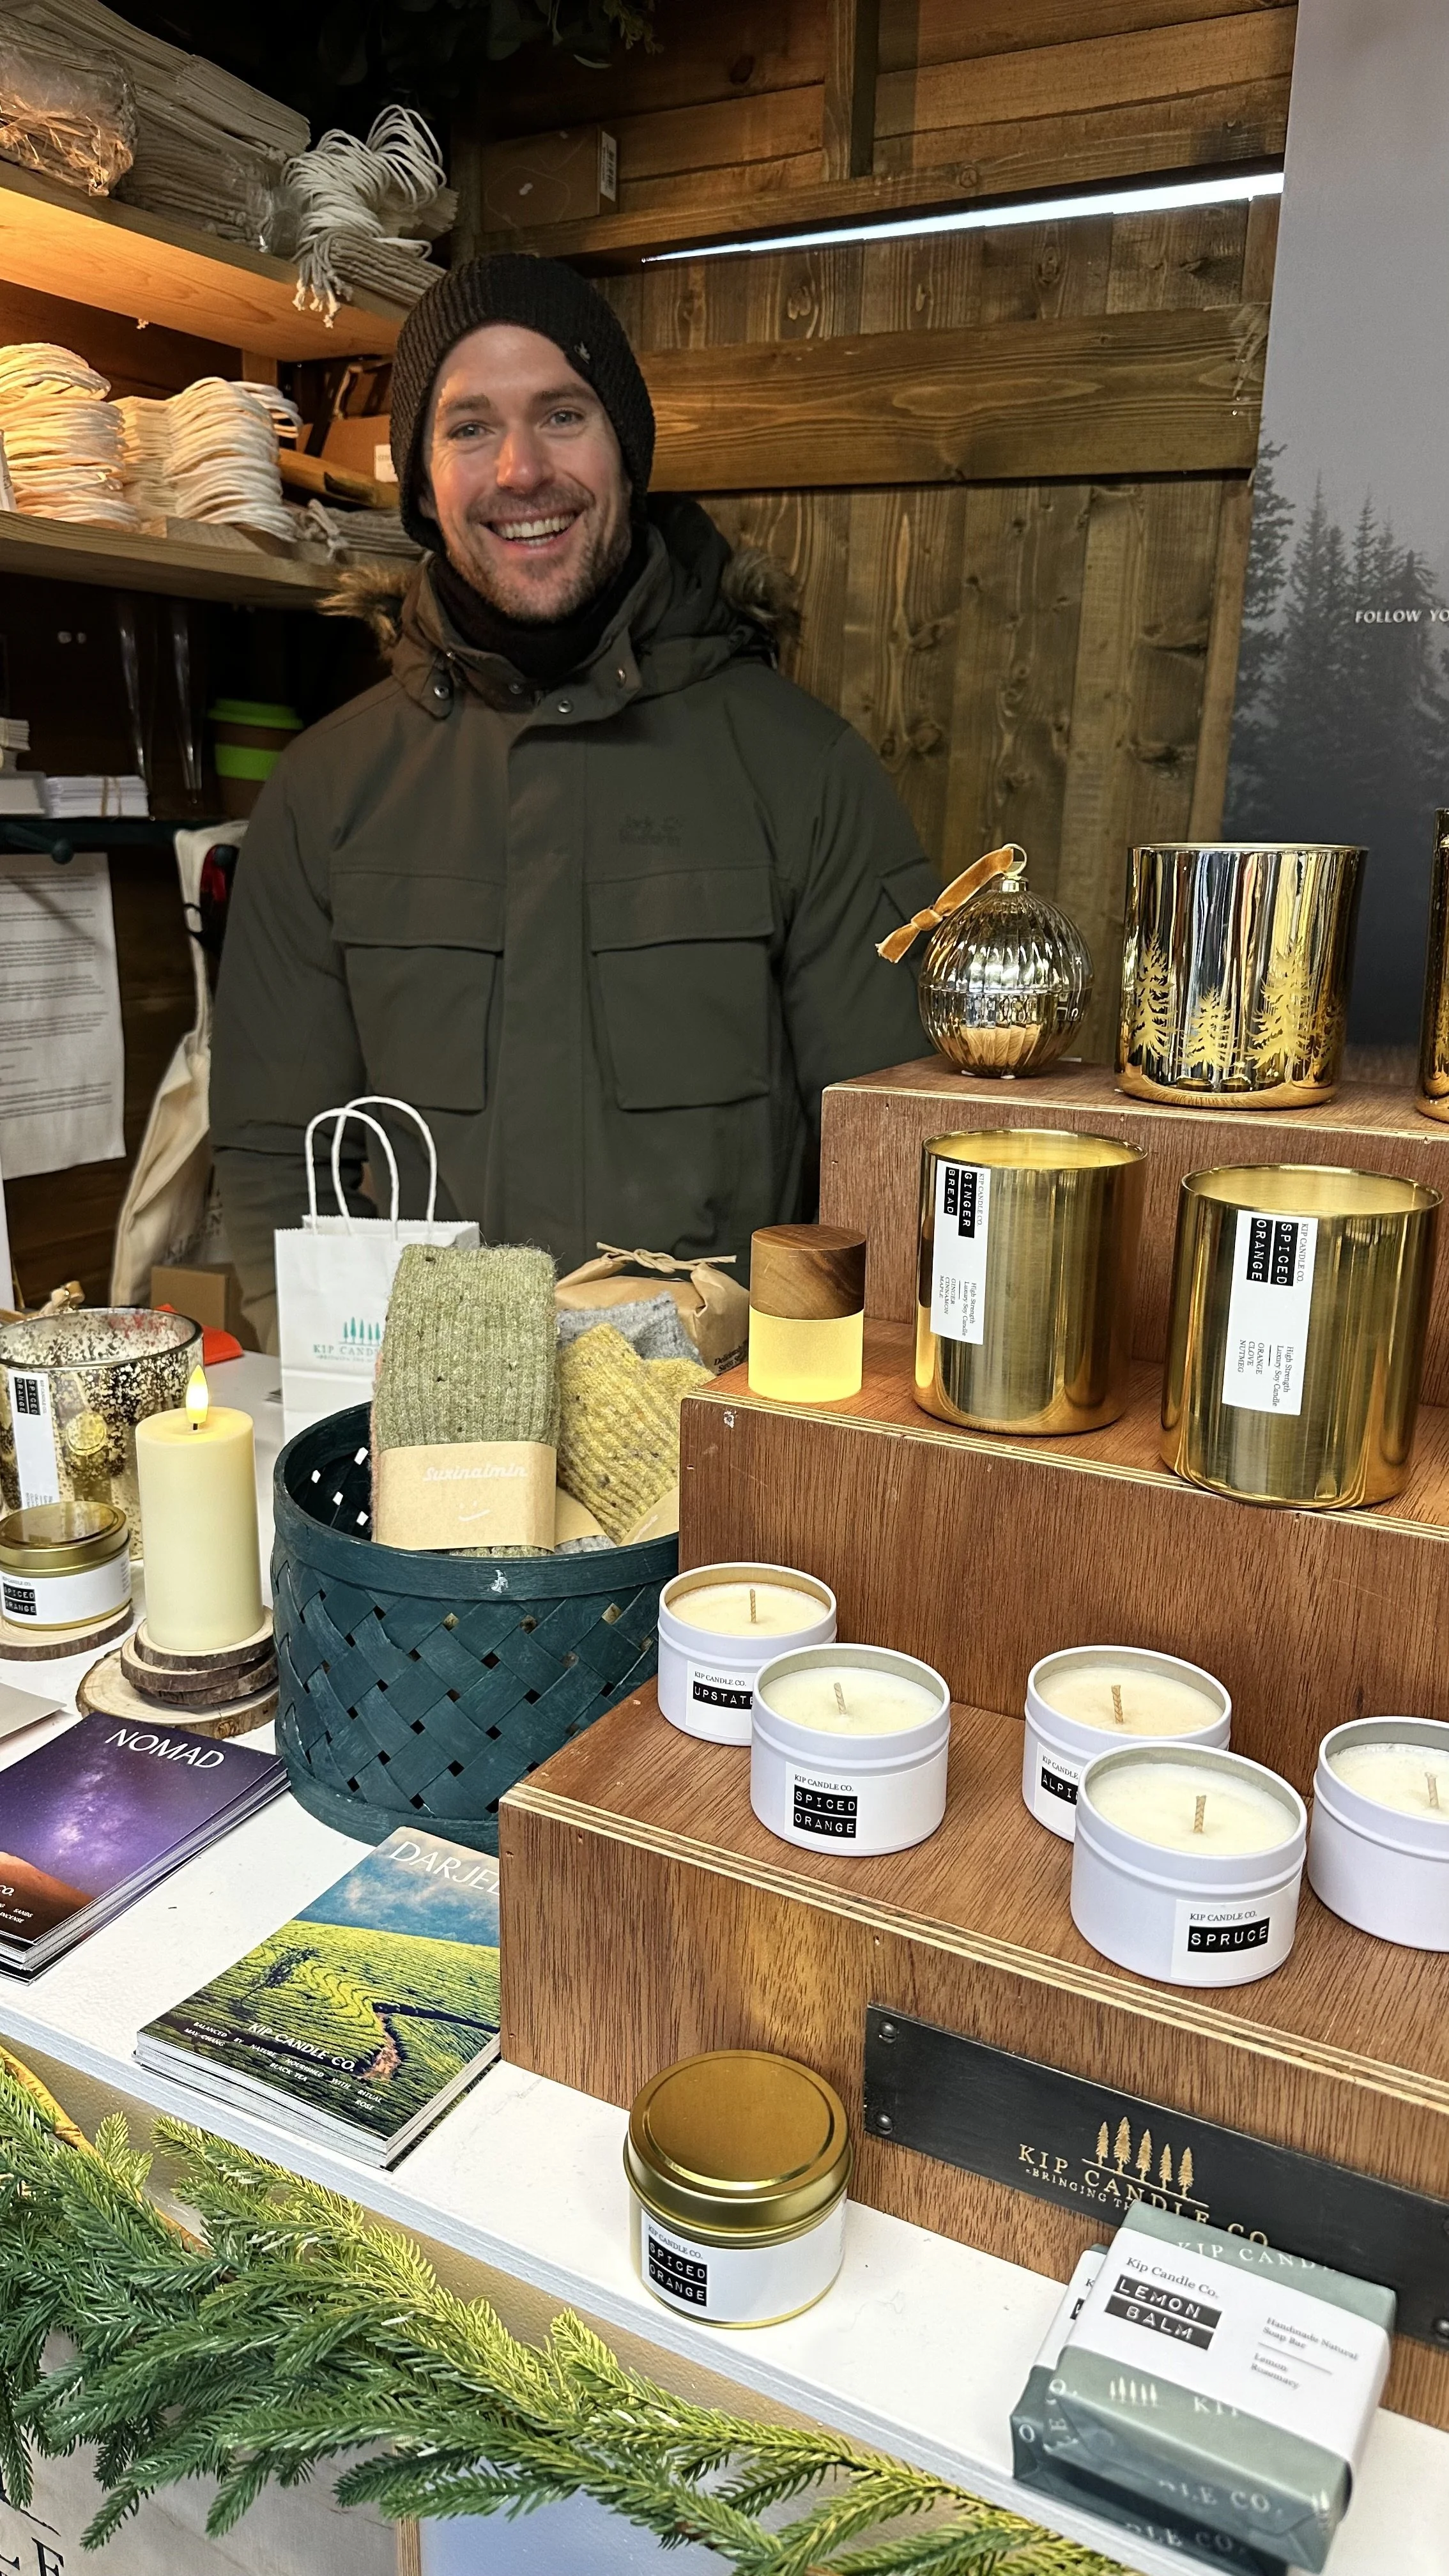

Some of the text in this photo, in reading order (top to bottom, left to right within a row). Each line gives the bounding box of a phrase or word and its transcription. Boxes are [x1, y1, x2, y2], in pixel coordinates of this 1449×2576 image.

[1354, 609, 1422, 624] FOLLOW
[947, 1169, 956, 1213] BREAD
[962, 1172, 972, 1227] GINGER
[1252, 1220, 1267, 1280] ORANGE
[1276, 1223, 1292, 1284] SPICED
[1298, 1238, 1307, 1269] CANDLE
[1238, 1339, 1246, 1373] NUTMEG
[1247, 1341, 1255, 1366] CLOVE
[1255, 1342, 1265, 1375] ORANGE
[1282, 1346, 1294, 1393] High Strength
[1272, 1345, 1284, 1407] Luxury Soy Candle
[694, 1671, 705, 1679] KIP
[705, 1675, 734, 1685] CANDLE
[105, 1728, 226, 1769] NOMAD
[794, 1774, 806, 1783] KIP
[807, 1779, 839, 1791] CANDLE
[1042, 1754, 1079, 1780] KIP CANDLE
[795, 1791, 855, 1811] SPICED
[1042, 1774, 1078, 1800] ALPI
[795, 1813, 854, 1834] ORANGE
[1190, 1910, 1257, 1922] KIP CANDLE CO.
[1190, 1925, 1268, 1947] SPRUCE
[192, 2021, 228, 2038] BALANCED
[284, 2057, 325, 2078] NOURISHED
[332, 2077, 351, 2090] WITH
[357, 2089, 383, 2104] RITUAL
[248, 2022, 355, 2073] KIP CANDLE CO.
[269, 2062, 308, 2082] BLACK TEA
[355, 2099, 376, 2111] ROSE
[1018, 2143, 1069, 2174] KIP
[648, 2224, 703, 2260] KIP CANDLE CO.
[649, 2242, 705, 2279] SPICED
[649, 2264, 705, 2301] ORANGE
[1126, 2257, 1220, 2299] Kip Candle Co.
[1119, 2278, 1202, 2320] LEMON
[1126, 2304, 1194, 2341] BALM
[1262, 2326, 1307, 2349] Soap Bar
[1266, 2317, 1359, 2361] Handmade Natural
[1250, 2362, 1300, 2390] Rosemary
[1254, 2352, 1288, 2372] Lemon
